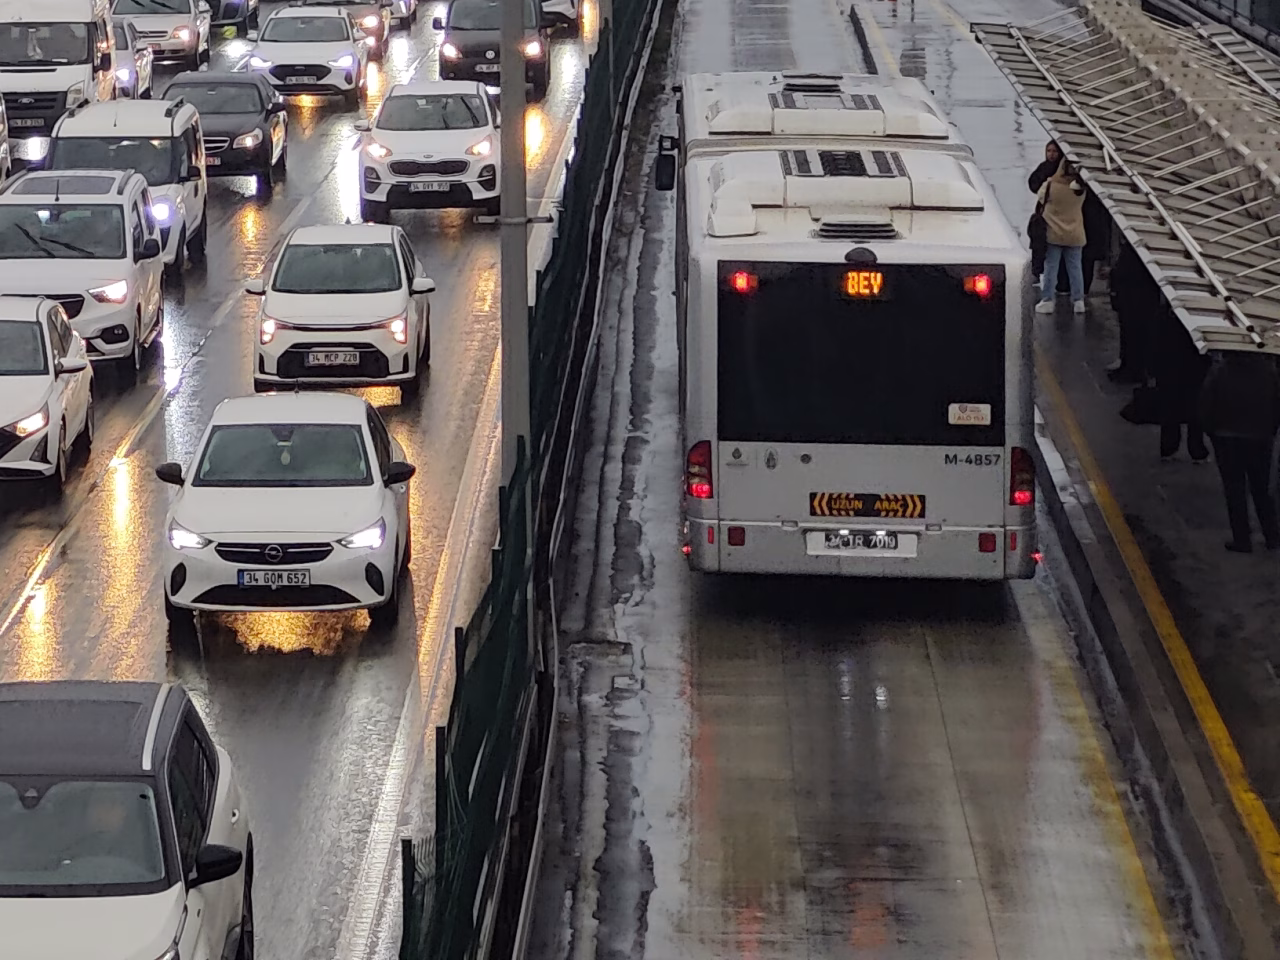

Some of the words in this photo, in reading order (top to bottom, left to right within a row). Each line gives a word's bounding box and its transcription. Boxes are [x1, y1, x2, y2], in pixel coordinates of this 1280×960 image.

[310, 353, 321, 363] 34
[944, 453, 1001, 466] M-4857
[831, 500, 863, 510] UZUN
[868, 535, 896, 548] 7019
[245, 572, 259, 584] 34
[286, 572, 307, 585] 652
